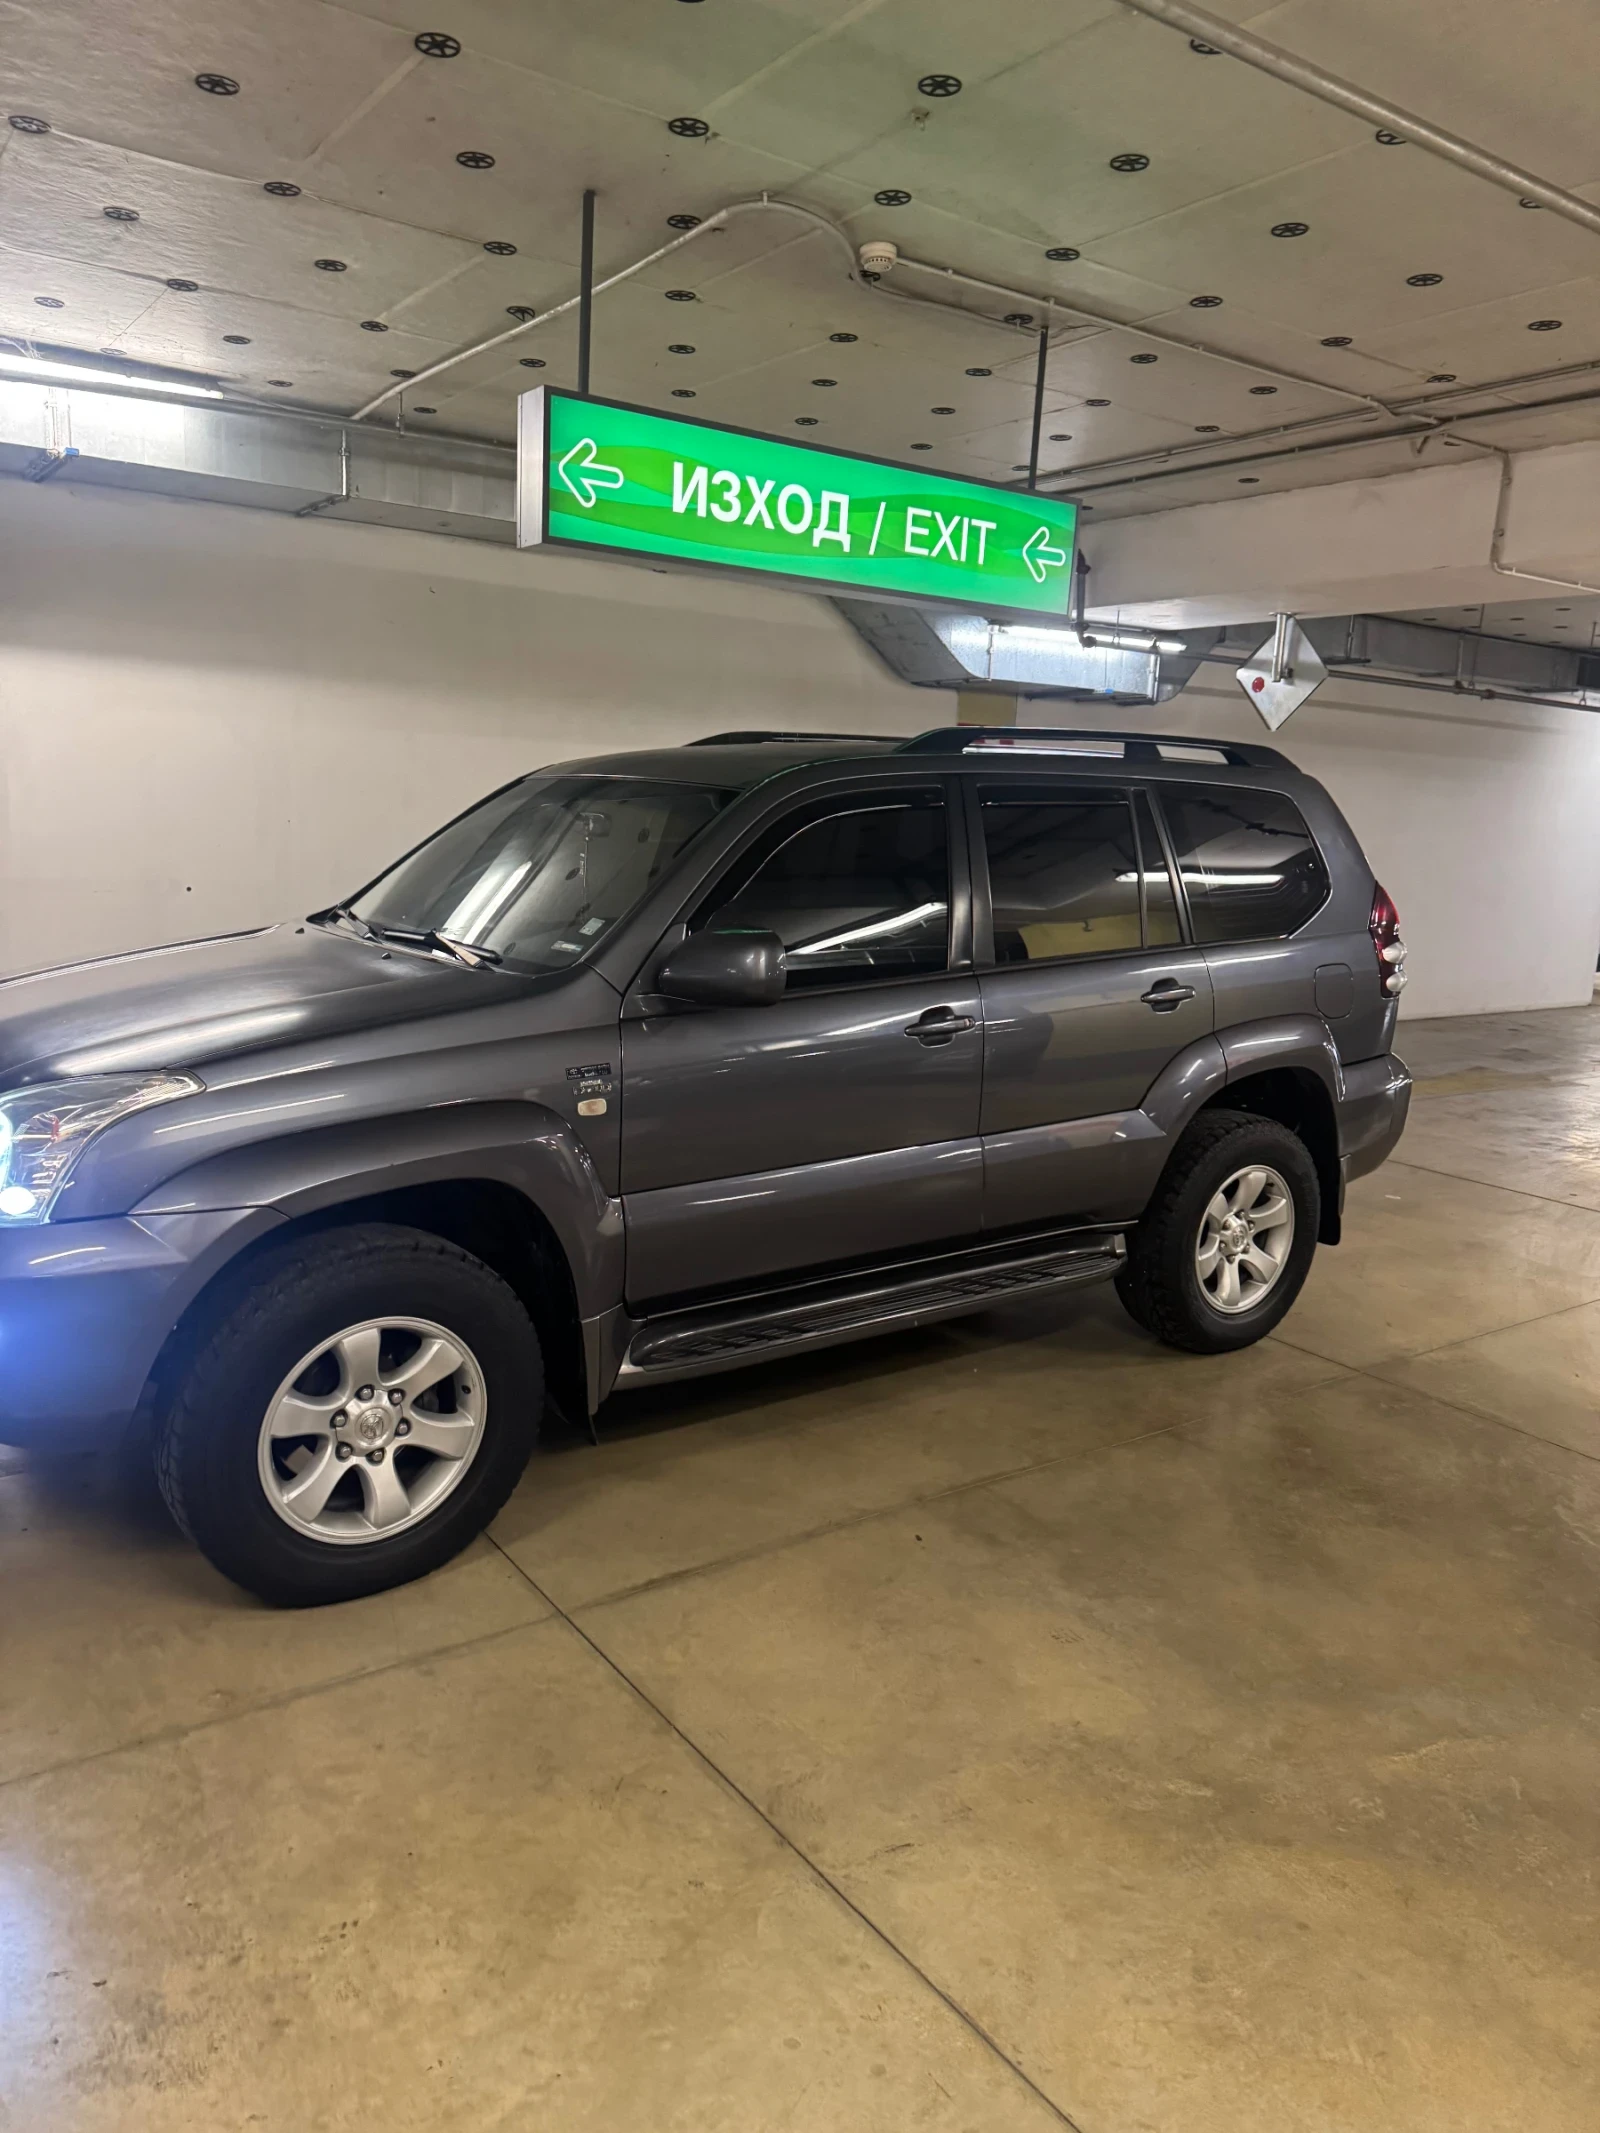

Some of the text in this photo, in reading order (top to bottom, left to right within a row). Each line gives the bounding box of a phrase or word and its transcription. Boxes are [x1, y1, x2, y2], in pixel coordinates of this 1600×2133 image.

[672, 461, 997, 565] ИЗХОД / EXIT
